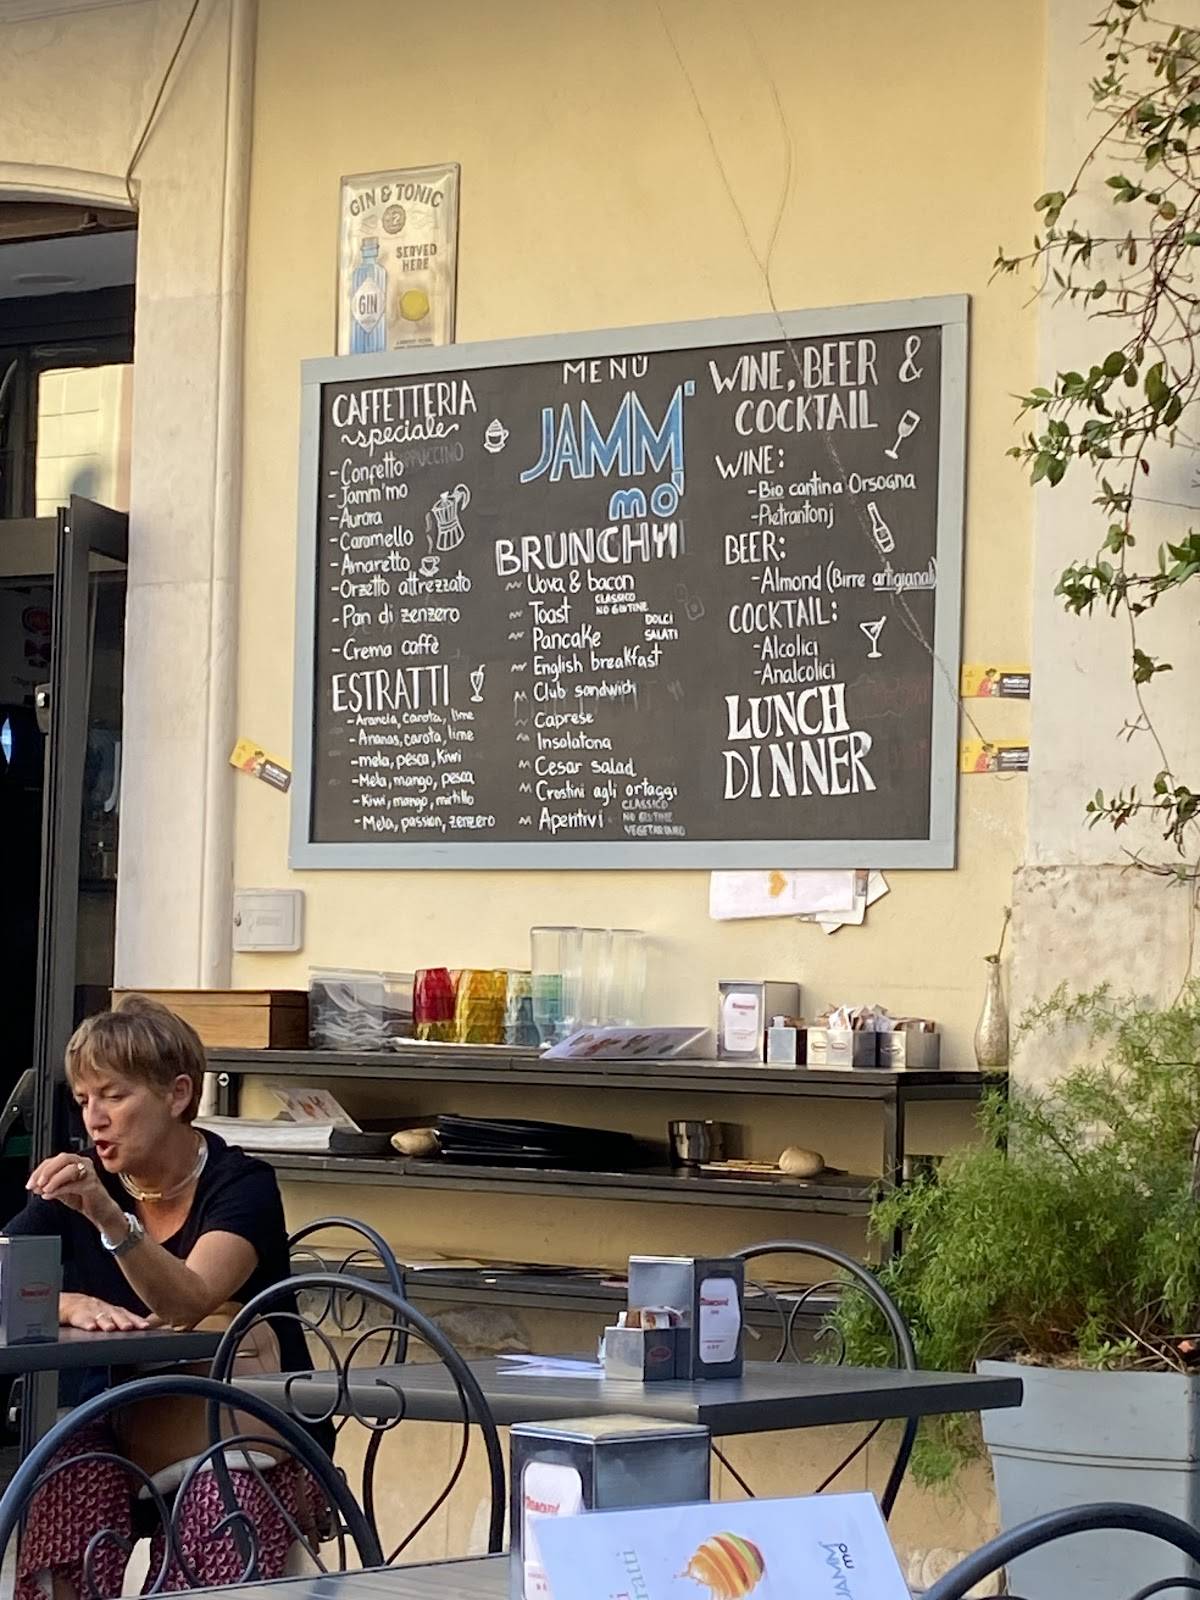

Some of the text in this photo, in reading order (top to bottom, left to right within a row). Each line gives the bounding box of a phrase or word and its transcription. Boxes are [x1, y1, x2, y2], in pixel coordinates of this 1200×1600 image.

[350, 183, 444, 216] GIN & TONIC
[396, 243, 438, 259] SERVED
[402, 258, 429, 272] HERE
[359, 293, 377, 315] GIN
[708, 335, 923, 394] WINE, BEER &
[333, 380, 477, 427] CAFFETTERIA
[734, 389, 879, 436] COCKTAIL
[341, 417, 459, 457] speciale
[715, 445, 785, 479] WINE:
[789, 470, 843, 497] cantina
[848, 472, 916, 494] Orsogna
[609, 483, 679, 521] mo
[495, 522, 650, 576] BRUNCH
[725, 530, 787, 565] BEER:
[398, 569, 471, 597] attrezzato
[528, 569, 635, 593] Uova & bacon
[528, 596, 572, 625] Toast
[595, 593, 636, 604] CLASSICO
[595, 605, 609, 615] NO
[379, 603, 393, 624] di
[400, 607, 460, 623] zenzero
[729, 596, 838, 634] COCKTAIL:
[533, 623, 601, 651] Pancake
[644, 628, 679, 641] SALATI
[533, 643, 663, 682] English breakfast
[332, 665, 449, 712] ESTRATTI
[533, 679, 637, 702] Club sandwich
[451, 708, 475, 722] lime
[534, 712, 594, 729] Caprese
[724, 683, 851, 740] LUNCH
[448, 725, 475, 741] lime
[537, 731, 612, 751] Insalatona
[535, 756, 637, 777] Cesar salad
[722, 731, 877, 800] DINNER
[441, 771, 475, 788] pesca
[536, 777, 679, 806] Crostini agli ortaggi
[436, 790, 474, 806] mirtillo
[621, 798, 669, 810] CLASSICO
[449, 815, 495, 829] zenzero
[539, 807, 604, 835] Aperitivi
